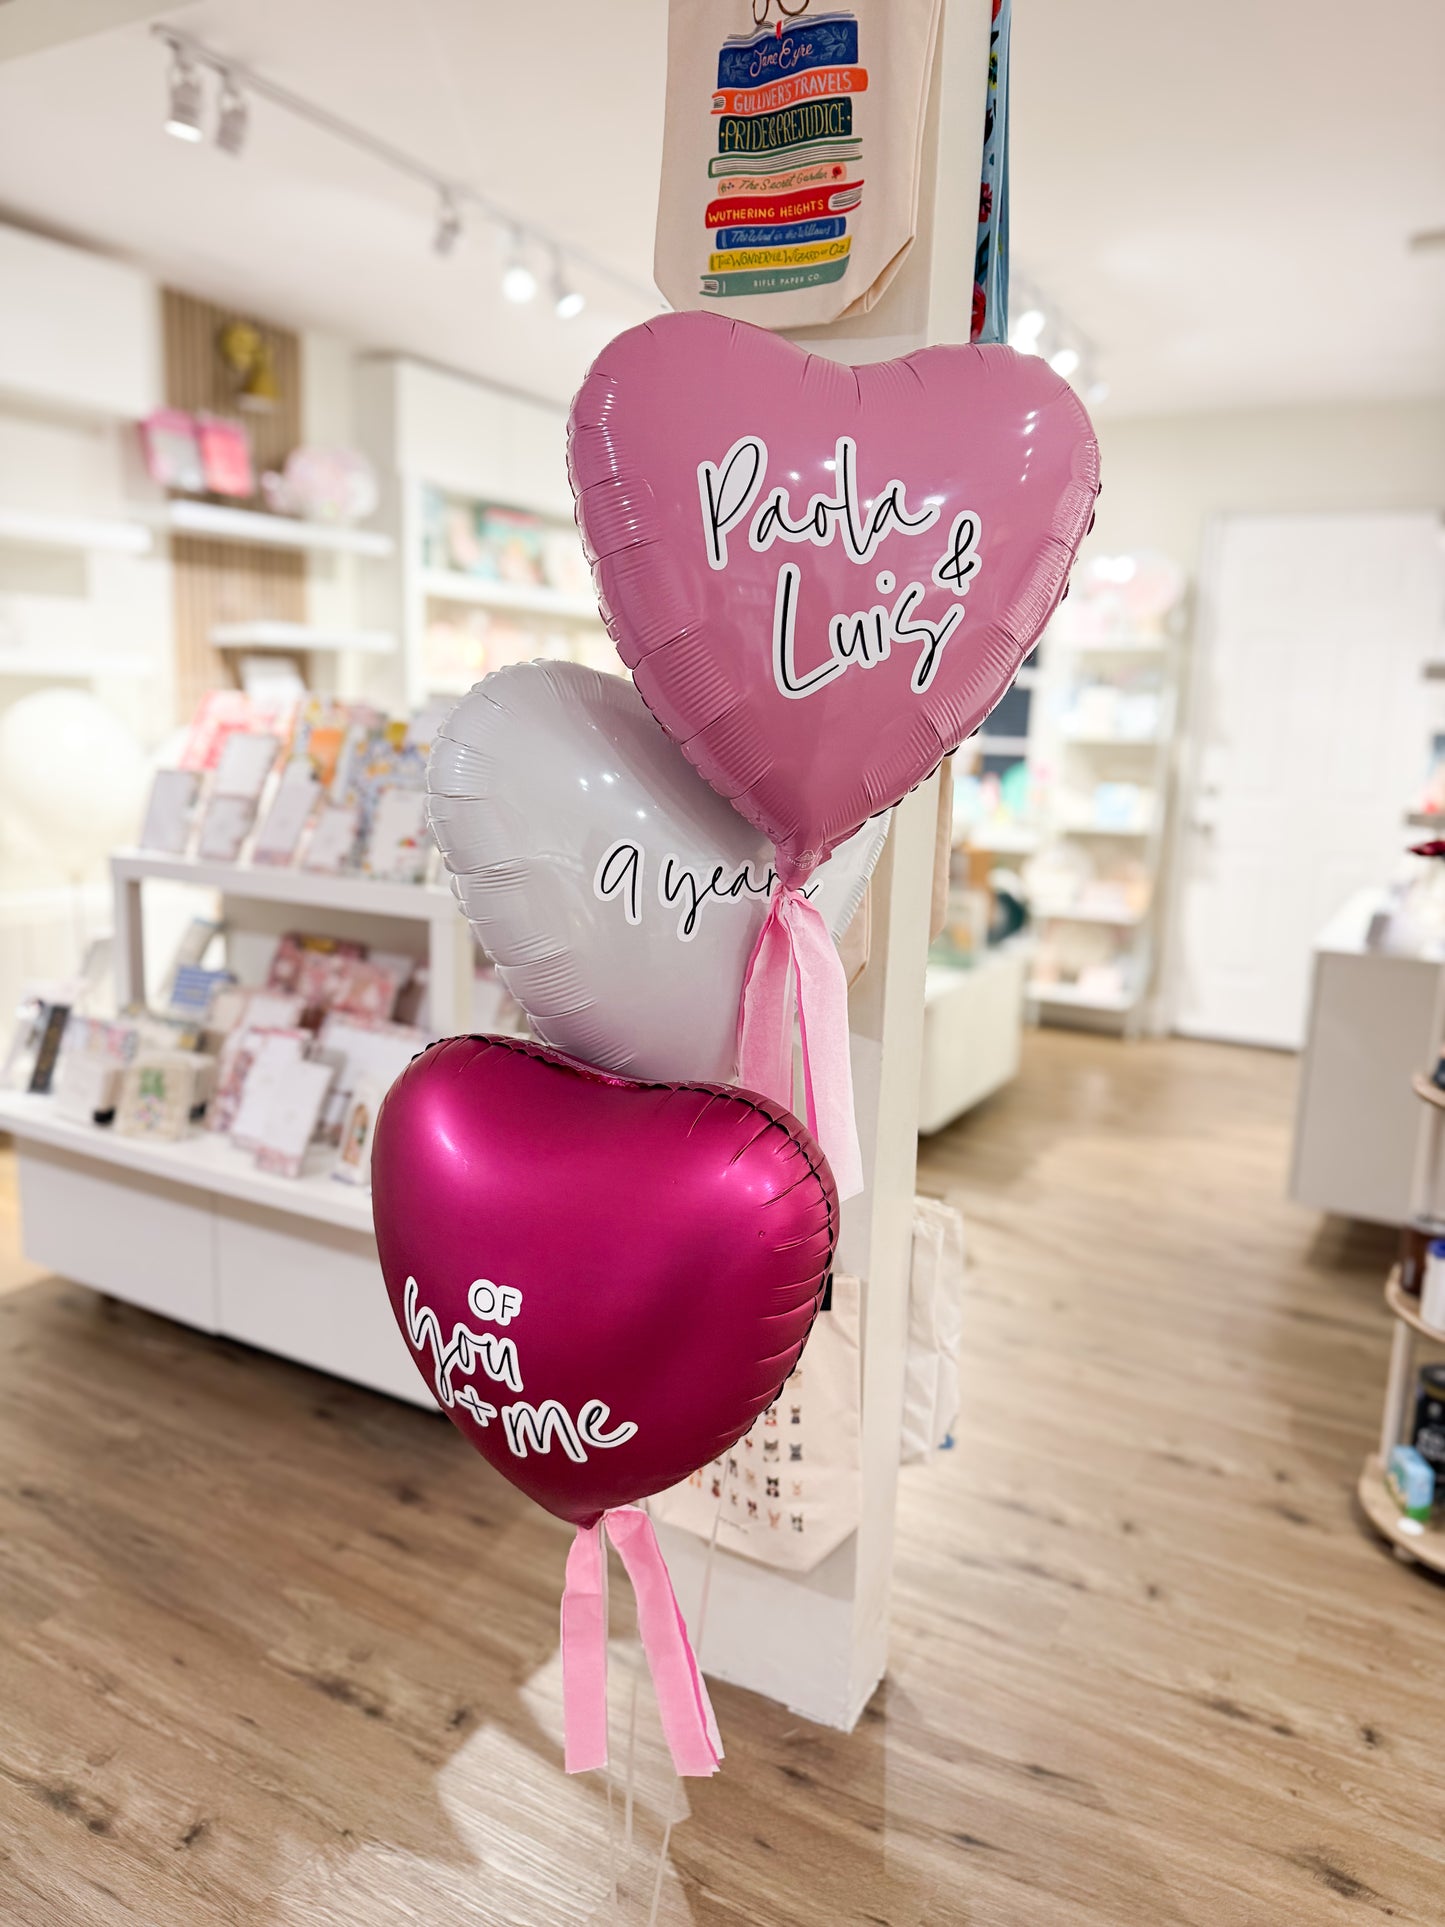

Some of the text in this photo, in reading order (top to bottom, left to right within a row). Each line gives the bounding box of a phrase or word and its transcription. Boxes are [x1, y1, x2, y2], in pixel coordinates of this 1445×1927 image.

[750, 38, 814, 77] Jane Eyre
[733, 71, 852, 113] GULLIVER'S TRAVELS
[739, 179, 759, 190] The
[760, 174, 796, 190] Secret
[708, 199, 824, 223] WUTHERING HEIGHTS
[753, 279, 776, 287] RIFLE
[780, 276, 804, 285] PAPER
[704, 442, 975, 588] Paola &
[779, 570, 958, 691] Luis
[600, 844, 639, 919] 9
[471, 1285, 518, 1320] OF
[407, 1282, 518, 1403] you
[507, 1404, 632, 1460] me
